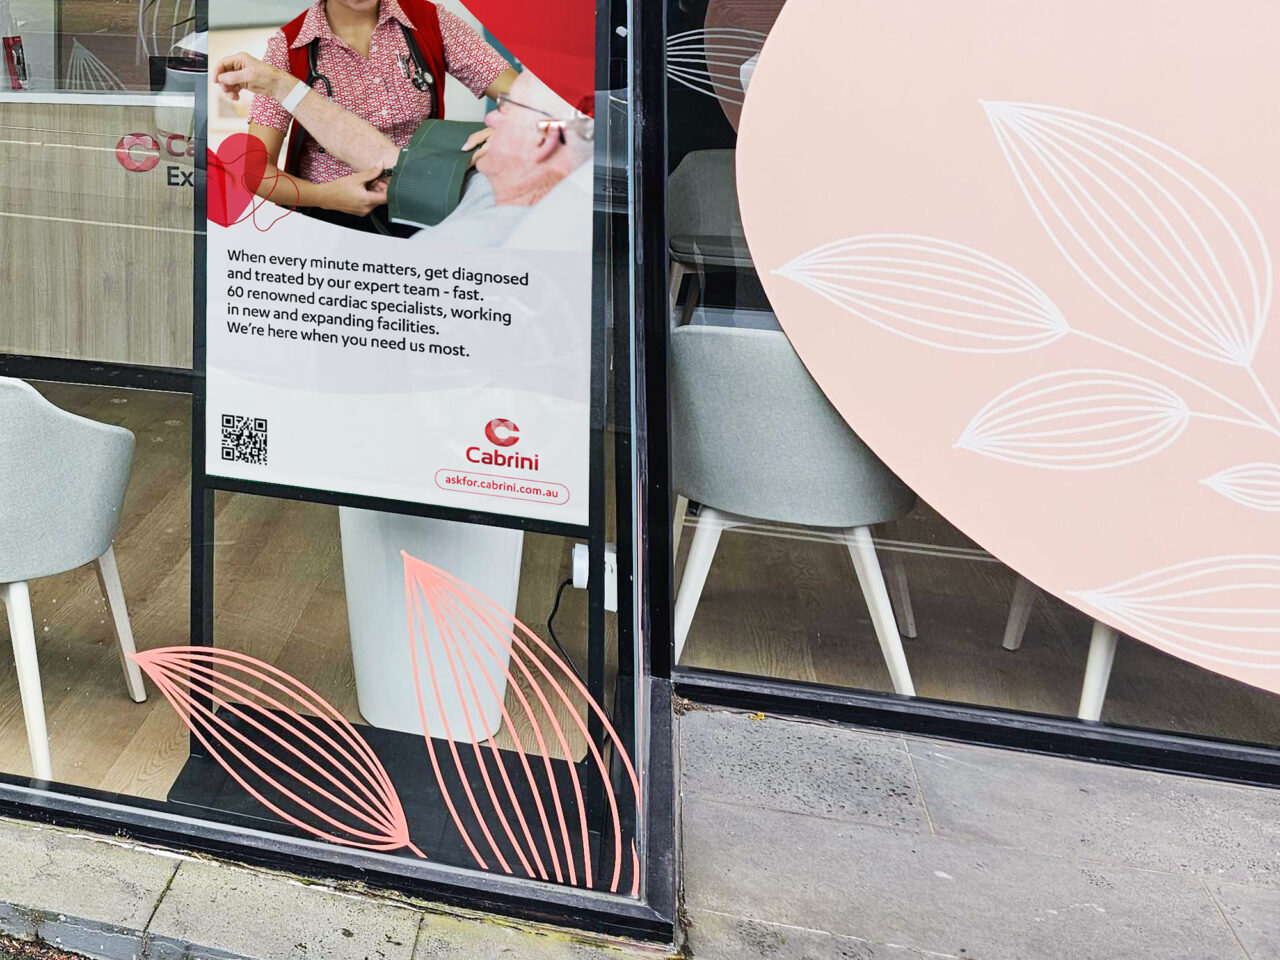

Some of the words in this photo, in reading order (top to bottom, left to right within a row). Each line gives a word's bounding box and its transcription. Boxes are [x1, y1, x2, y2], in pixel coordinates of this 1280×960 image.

[227, 249, 266, 264] When
[269, 255, 307, 270] every
[310, 256, 359, 271] minute
[362, 263, 421, 279] matters,
[424, 267, 449, 281] get
[452, 267, 529, 285] diagnosed
[227, 268, 252, 280] and
[255, 270, 304, 285] treated
[308, 273, 324, 289] by
[328, 278, 351, 289] our
[354, 280, 401, 295] expert
[404, 284, 440, 297] team
[453, 286, 484, 301] fast.
[227, 286, 244, 298] 60
[247, 289, 315, 304] renowned
[318, 295, 368, 309] cardiac
[371, 300, 447, 319] specialists,
[451, 307, 512, 326] working
[227, 302, 239, 315] in
[242, 307, 270, 318] new
[273, 308, 298, 321] and
[301, 314, 374, 331] expanding
[377, 316, 440, 335] facilities.
[227, 321, 264, 336] We’re
[268, 324, 298, 339] here
[300, 329, 338, 344] when
[342, 335, 367, 347] you
[371, 337, 406, 351] need
[410, 341, 425, 352] us
[429, 343, 470, 357] most.
[466, 446, 539, 471] Cabrini
[445, 475, 558, 498] askfor.cabrini.com.au
